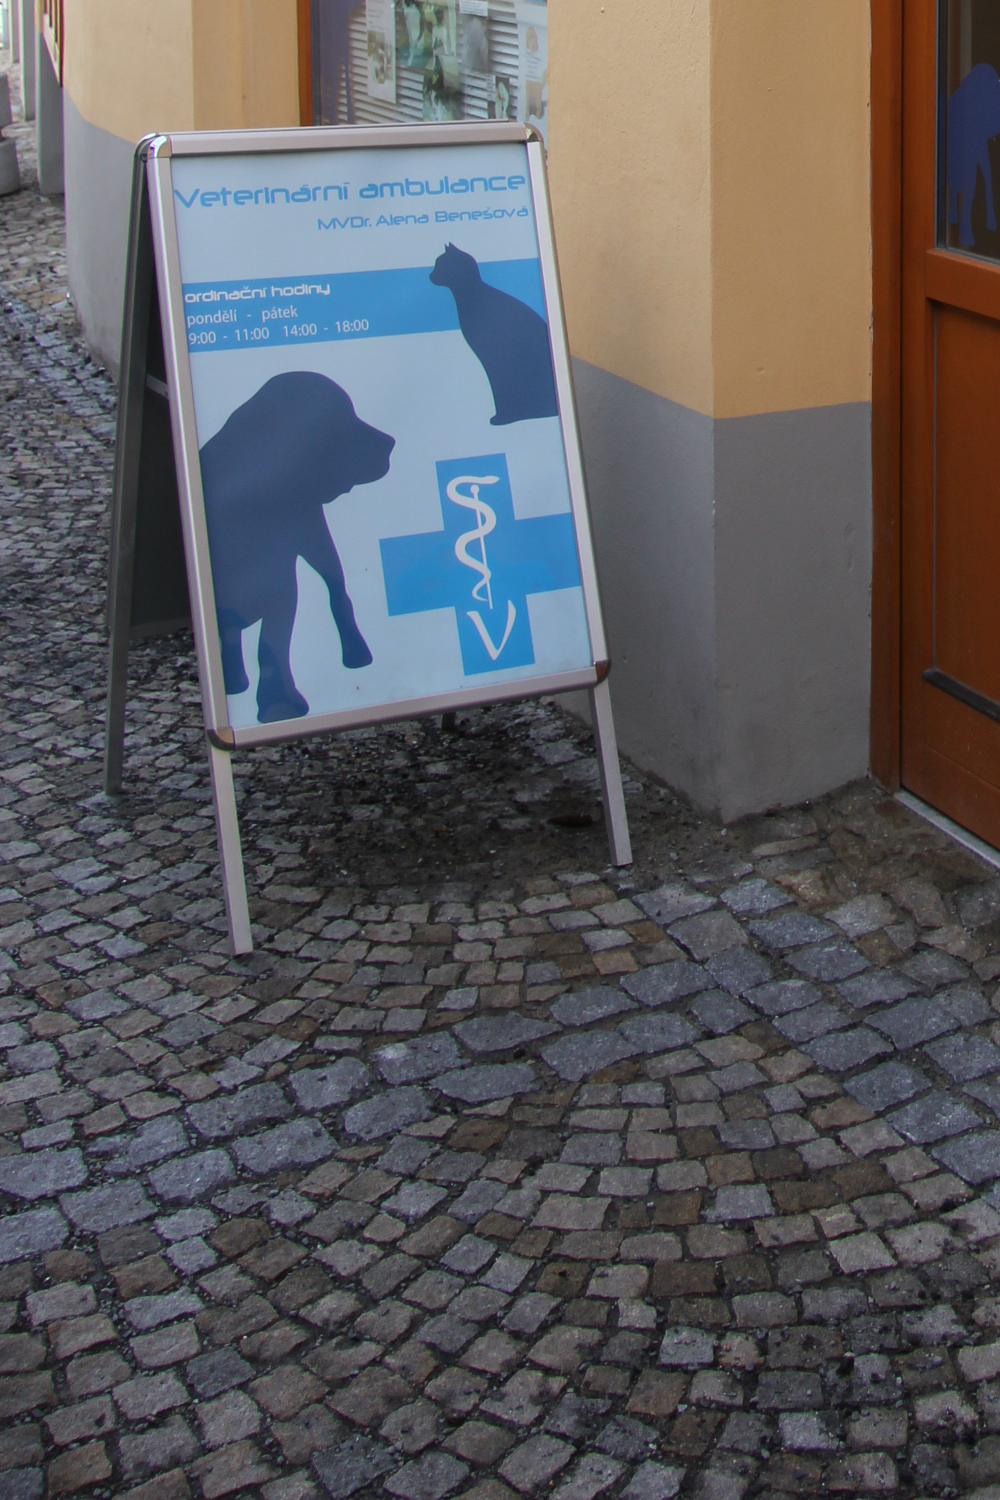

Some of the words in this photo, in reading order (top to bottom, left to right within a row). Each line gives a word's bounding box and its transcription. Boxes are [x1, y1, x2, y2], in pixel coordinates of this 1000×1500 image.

[174, 181, 351, 208] Veterinární
[359, 174, 526, 199] ambulance
[317, 215, 372, 231] MVDr.
[375, 213, 430, 227] Alena
[434, 206, 529, 223] Benešová
[184, 285, 267, 304] ordinační
[270, 283, 331, 298] hodiny
[186, 309, 237, 328] pondělí
[261, 305, 298, 323] pátek
[188, 330, 216, 345] 9:00
[235, 326, 270, 341] 11:00
[283, 322, 317, 338] 14:00
[335, 318, 369, 334] 18:00
